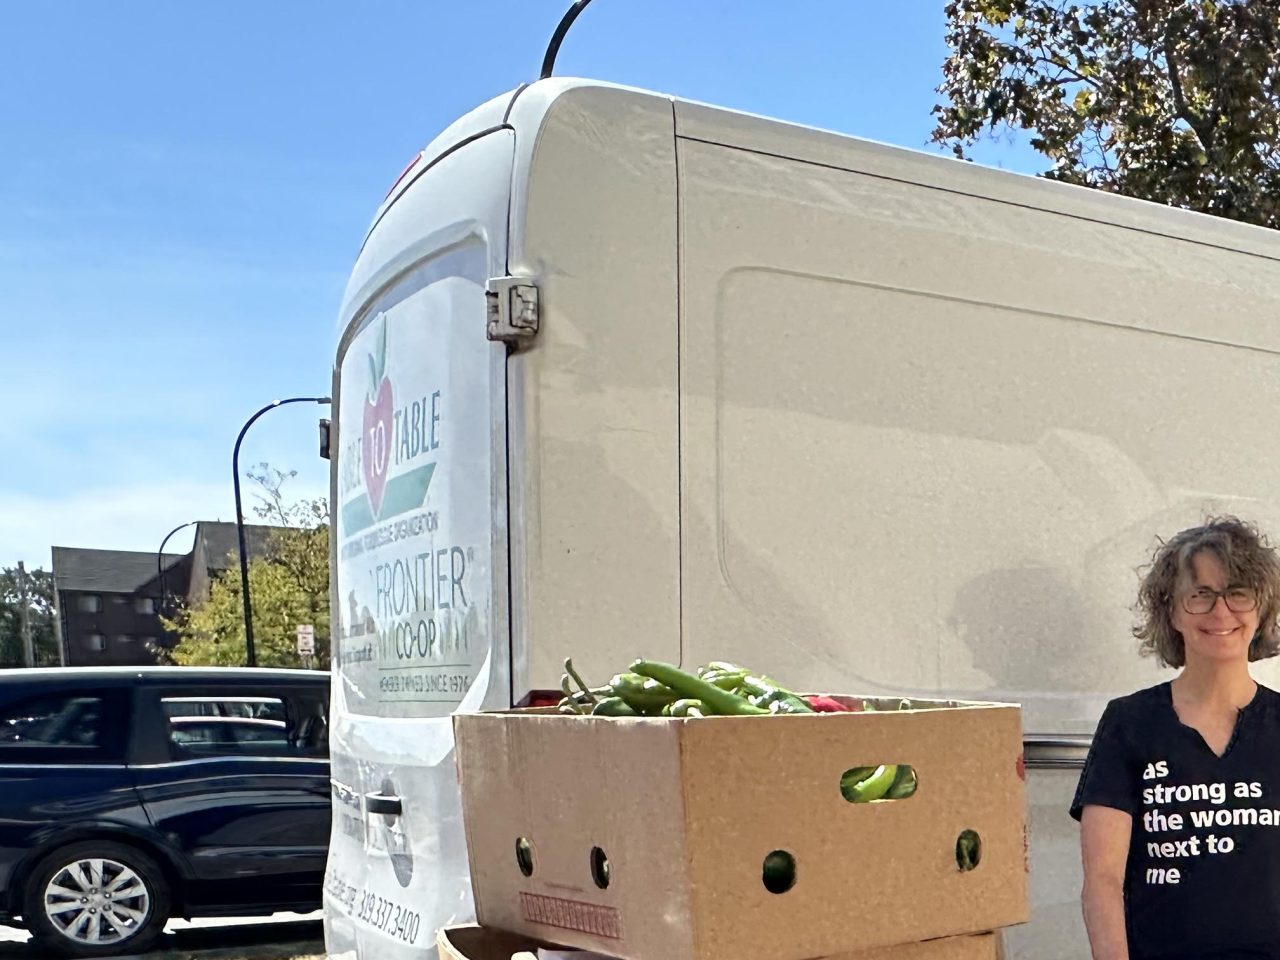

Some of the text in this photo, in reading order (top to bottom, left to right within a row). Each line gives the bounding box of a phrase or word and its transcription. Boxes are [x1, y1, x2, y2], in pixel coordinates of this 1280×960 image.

[369, 420, 386, 478] TO
[394, 389, 440, 466] TABLE
[375, 545, 468, 619] FRONTIER
[395, 618, 437, 661] CO-OP
[1142, 760, 1169, 780] as
[1142, 781, 1263, 804] strong as
[1143, 809, 1184, 833] the
[1147, 834, 1235, 858] next to
[1146, 867, 1181, 885] me
[358, 888, 420, 945] 319.337.3400
